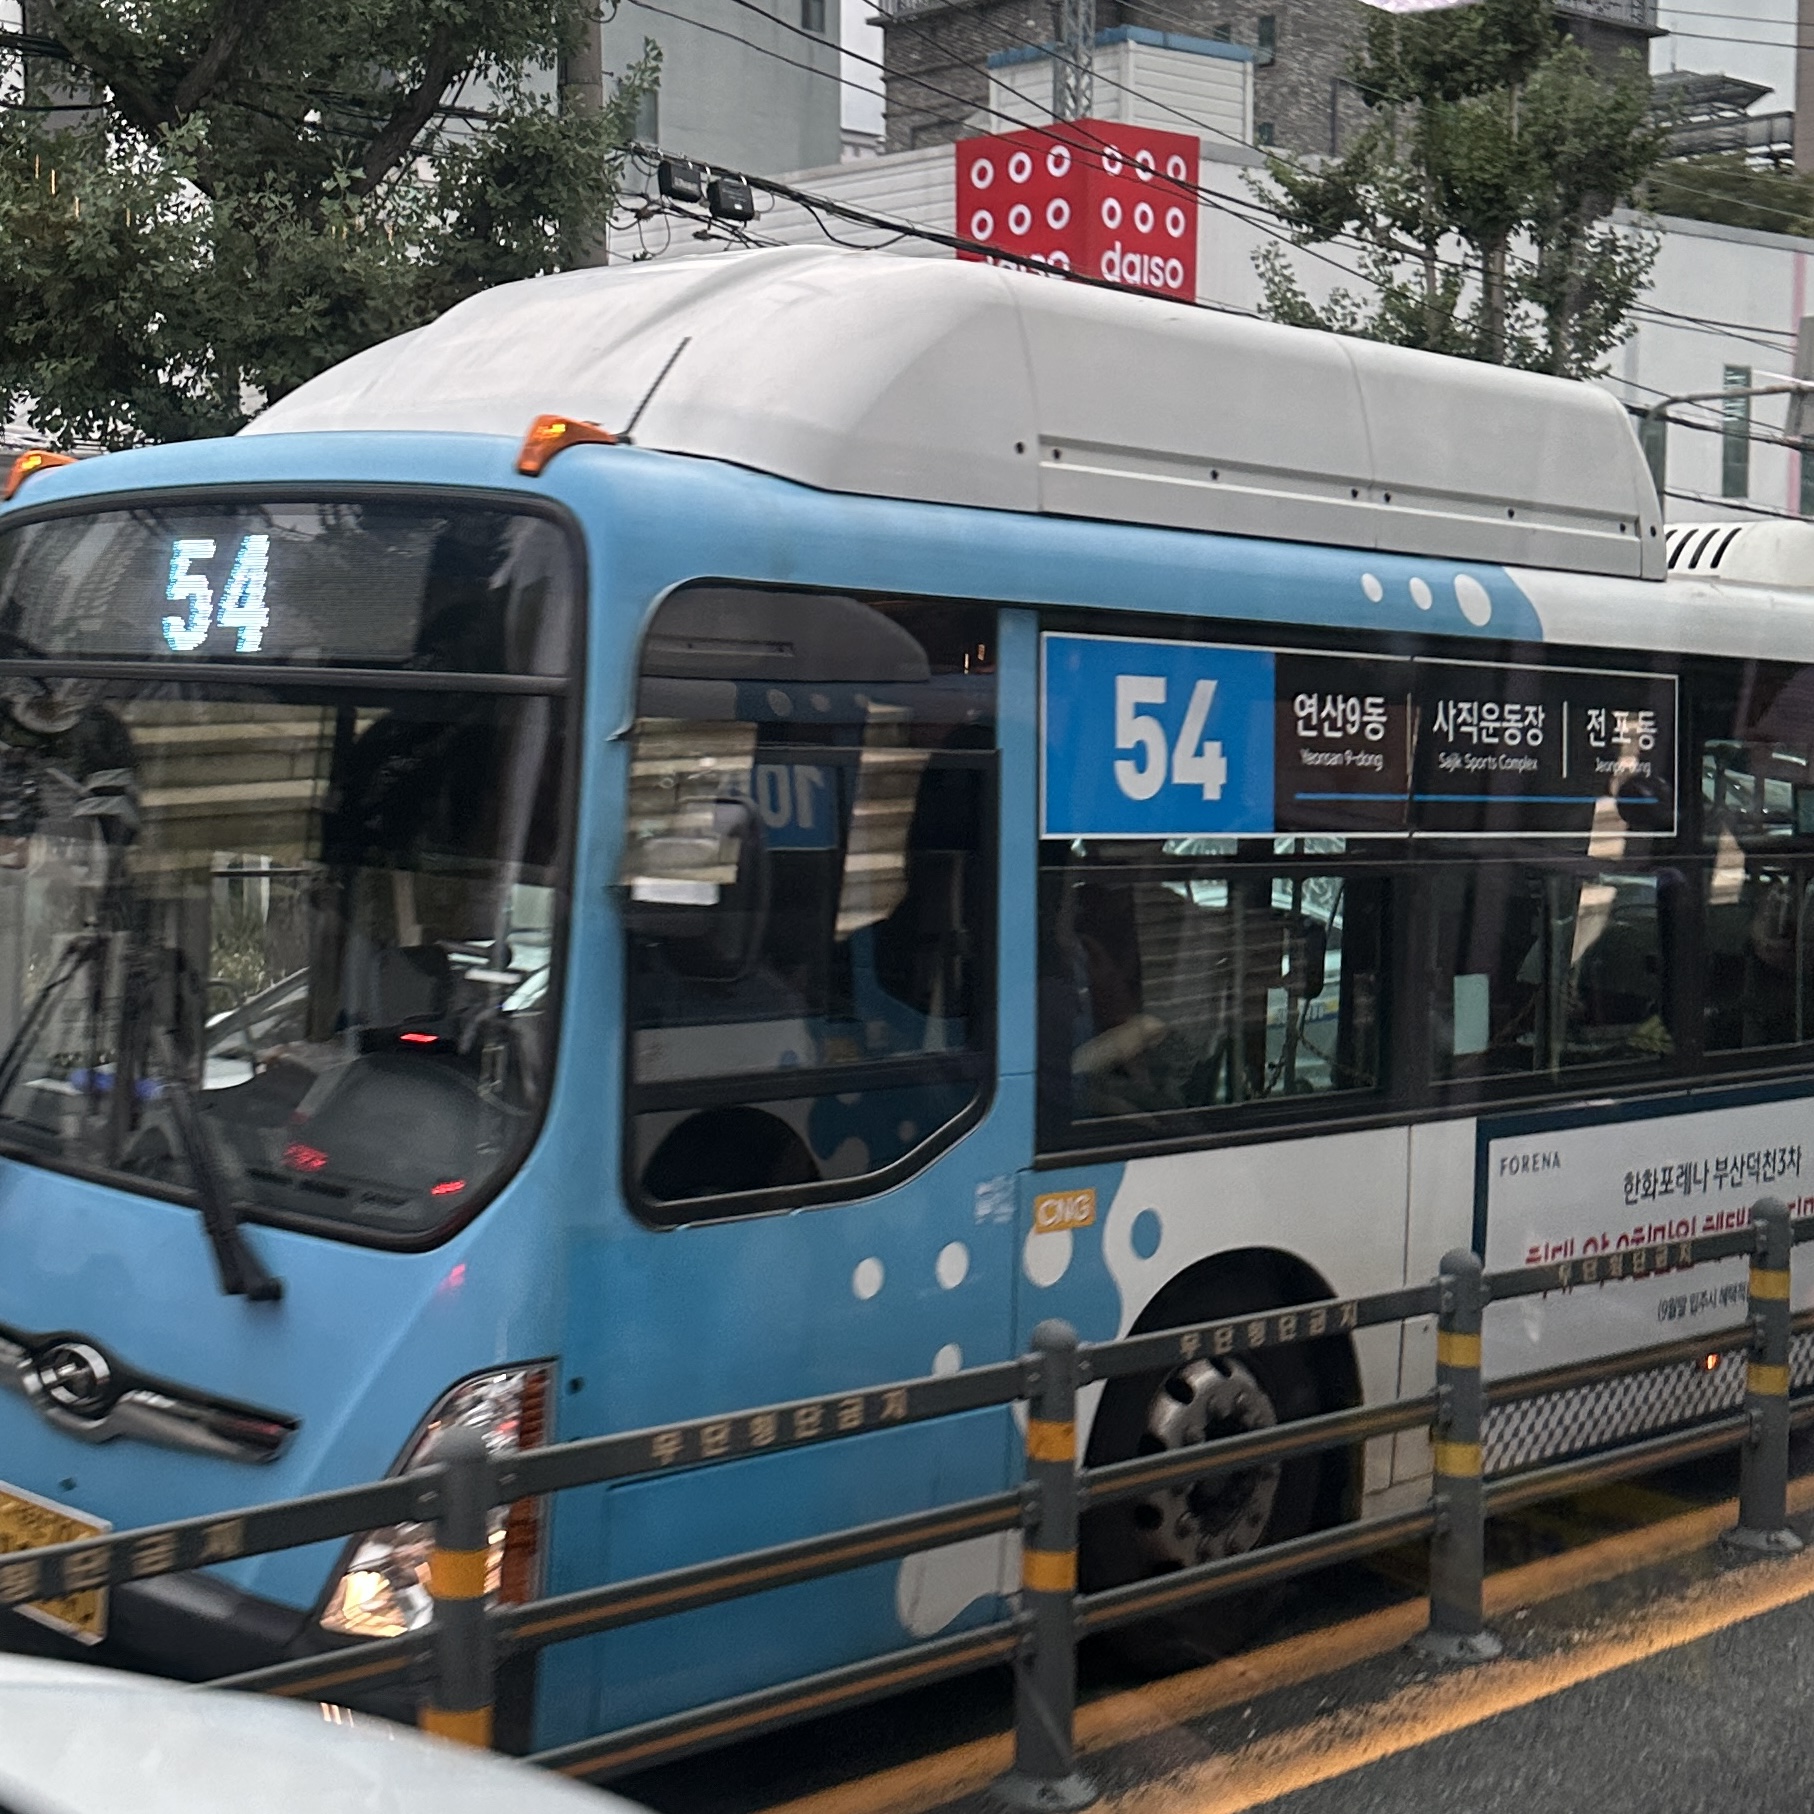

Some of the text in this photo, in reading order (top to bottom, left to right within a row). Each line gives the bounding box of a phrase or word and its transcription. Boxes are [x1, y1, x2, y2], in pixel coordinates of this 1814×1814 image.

[1101, 240, 1184, 289] daiso
[162, 534, 270, 652] 54
[1114, 675, 1227, 800] 54
[1294, 692, 1388, 741] 연산9동
[1432, 700, 1545, 746] 사직운동장
[1586, 708, 1658, 750] 전포동
[1464, 753, 1498, 773] Sports
[1499, 754, 1539, 773] Complex
[1500, 1151, 1561, 1177] FORENA
[1623, 1159, 1709, 1205] 한화포레나
[1039, 1194, 1092, 1227] CNG
